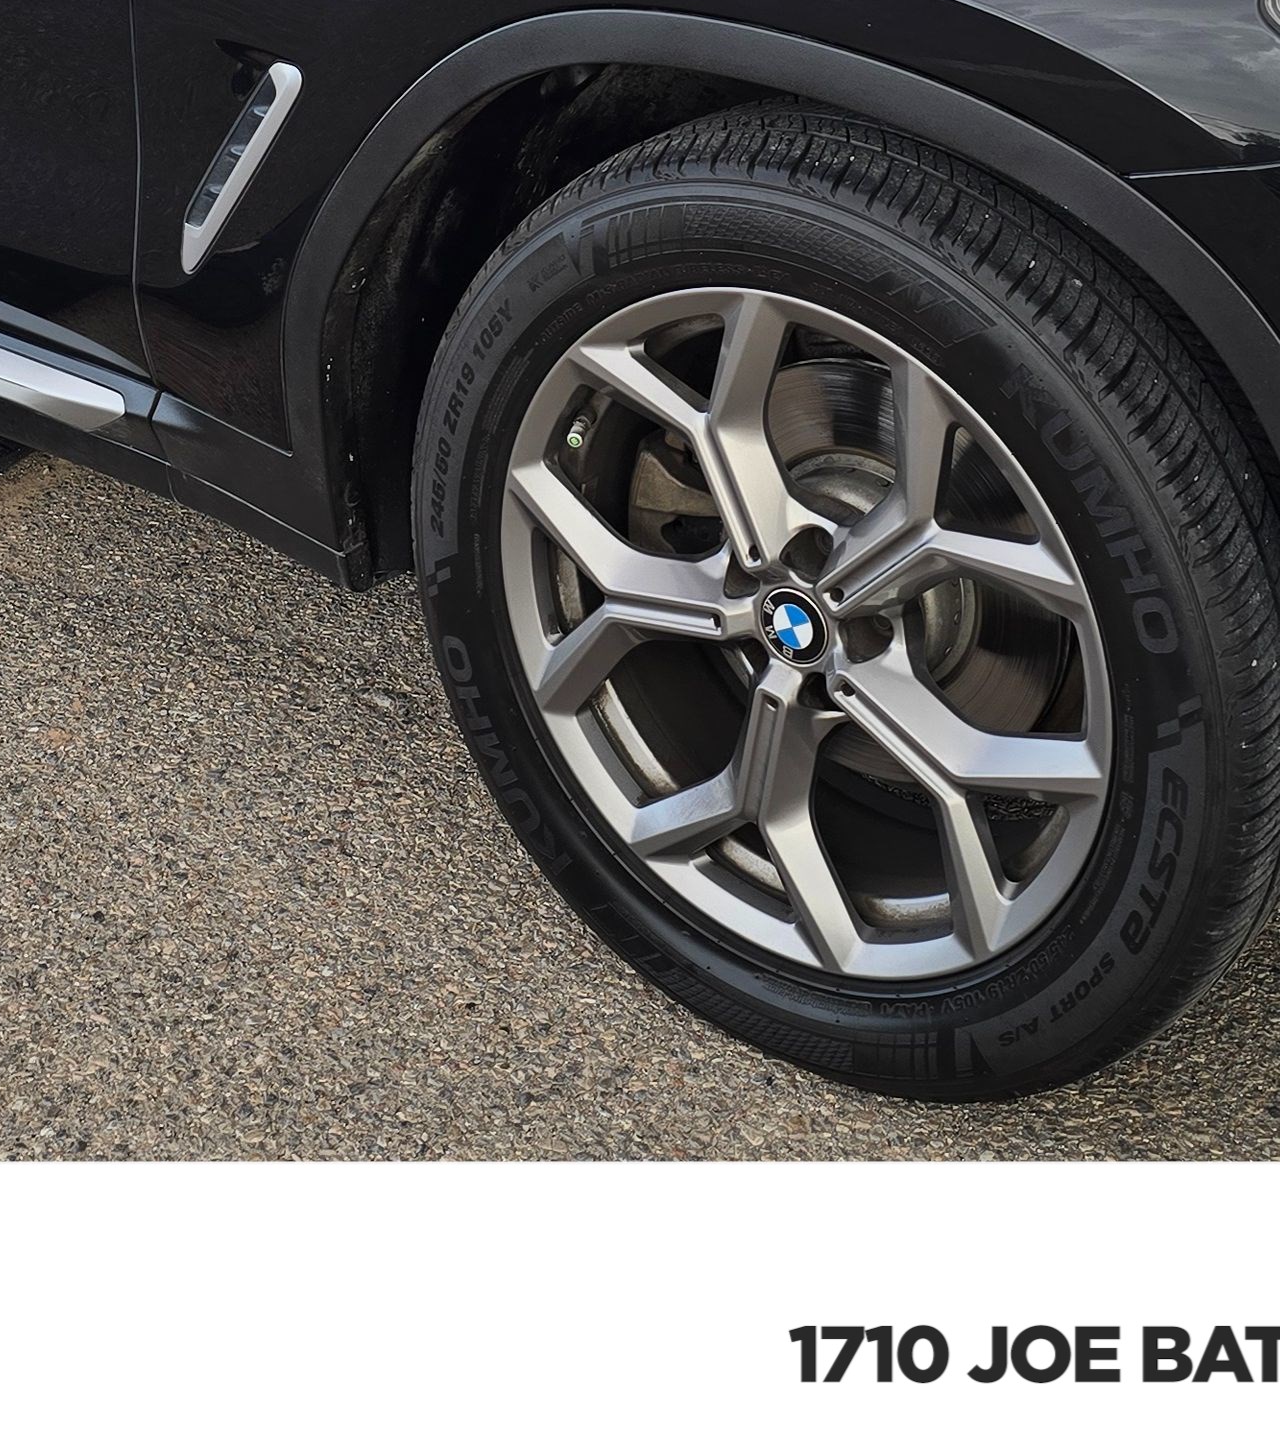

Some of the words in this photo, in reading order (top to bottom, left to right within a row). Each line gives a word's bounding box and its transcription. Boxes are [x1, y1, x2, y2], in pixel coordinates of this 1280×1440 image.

[429, 436, 453, 538] 245/50
[443, 361, 476, 436] ZR19
[471, 297, 514, 361] 105Y
[998, 362, 1179, 655] KUMHO
[762, 598, 794, 659] BMW
[442, 634, 573, 877] KUMHO
[998, 1015, 1040, 1047] A/S
[1049, 951, 1116, 1024] SPORT
